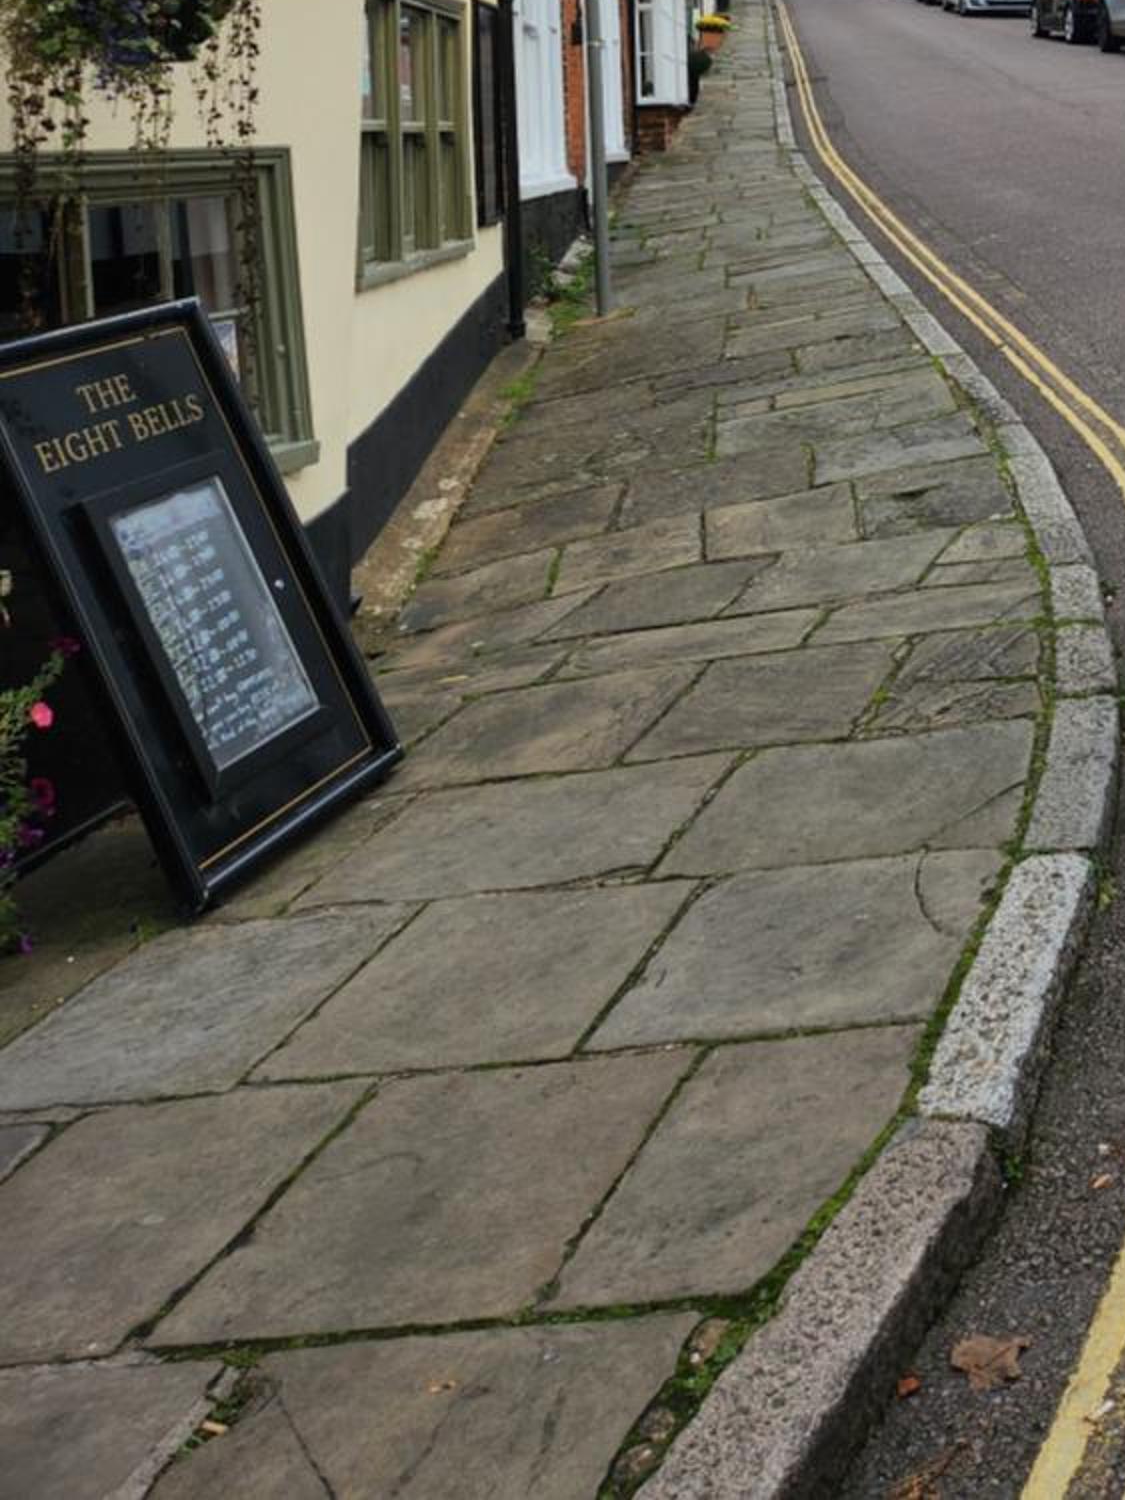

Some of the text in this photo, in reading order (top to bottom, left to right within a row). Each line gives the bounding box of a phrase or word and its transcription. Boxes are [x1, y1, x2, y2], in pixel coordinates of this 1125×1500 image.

[76, 373, 137, 414] THE
[34, 393, 205, 473] EIGHT BELLS
